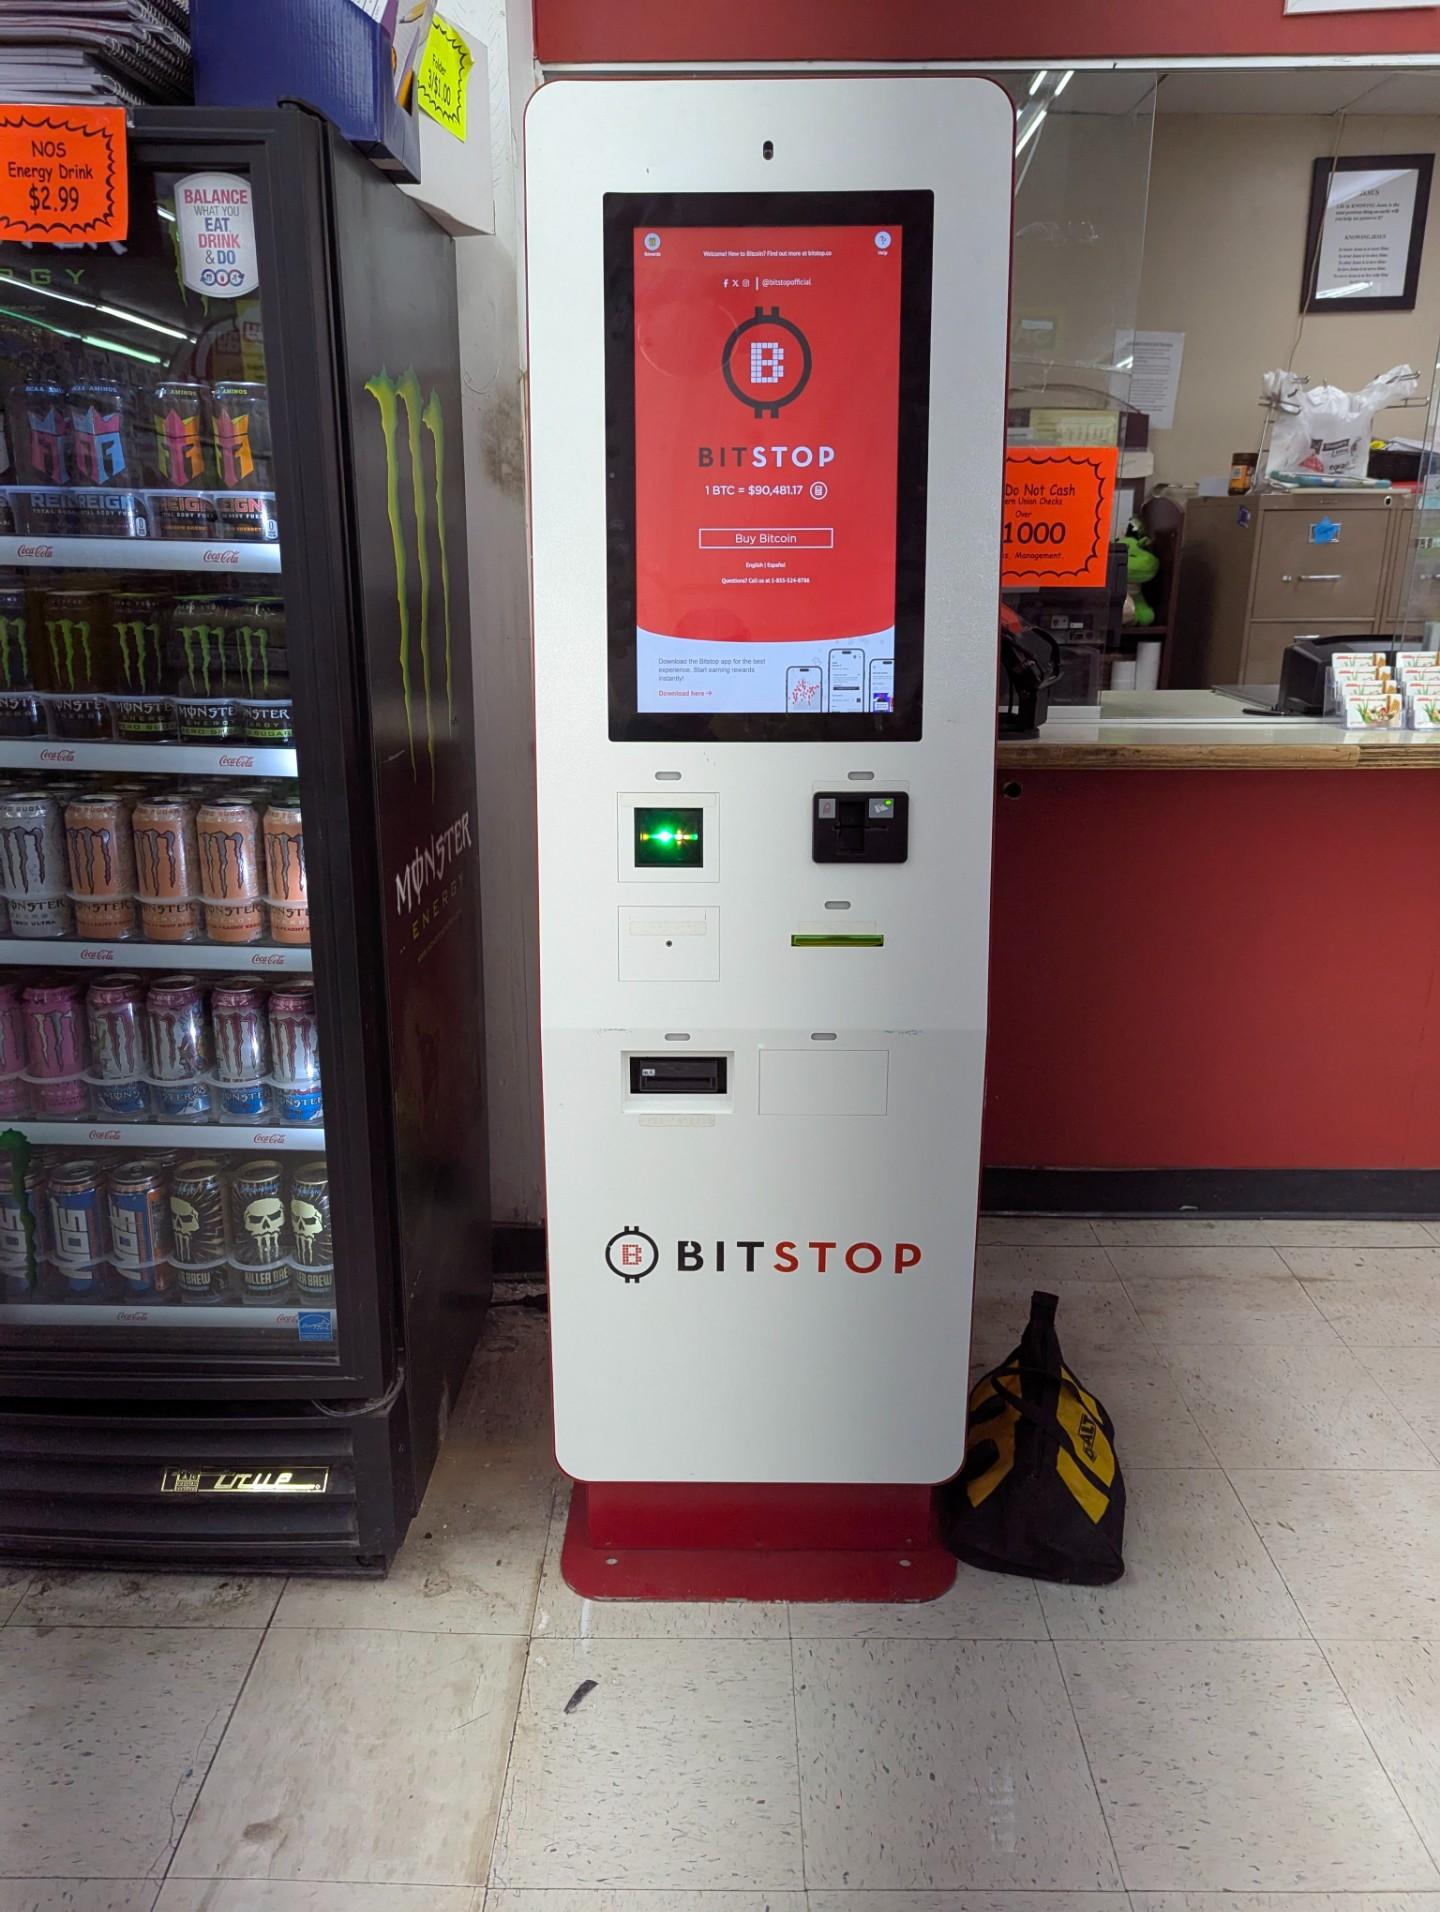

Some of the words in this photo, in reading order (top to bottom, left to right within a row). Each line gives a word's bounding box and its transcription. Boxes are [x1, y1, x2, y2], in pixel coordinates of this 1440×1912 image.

[31, 140, 67, 158] NOS
[8, 161, 53, 183] Energy
[59, 163, 94, 180] Drink
[29, 183, 80, 216] $2.99
[184, 189, 248, 204] BALANCE
[194, 205, 219, 216] WHAT
[222, 206, 240, 217] YOU
[198, 234, 241, 249] DRINK
[205, 250, 215, 264] &
[217, 250, 236, 264] DO
[762, 278, 812, 287] @bitstopofficial
[698, 446, 836, 468] BITSTOP
[705, 485, 710, 495] 1
[712, 485, 735, 495] BTC
[748, 485, 803, 497] $90,481.17
[1005, 483, 1019, 496] Do
[1024, 483, 1046, 496] Not
[1049, 483, 1076, 496] Cash
[1018, 497, 1037, 505] Union
[1040, 497, 1063, 505] Checks
[1015, 510, 1032, 519] Over
[735, 533, 756, 544] Buy
[760, 533, 797, 543] Bitcoin
[1003, 521, 1066, 545] 1000
[720, 659, 732, 667] app
[395, 811, 472, 916] MONSTER
[677, 1240, 922, 1274] BITSTOP
[272, 1266, 288, 1282] BRE
